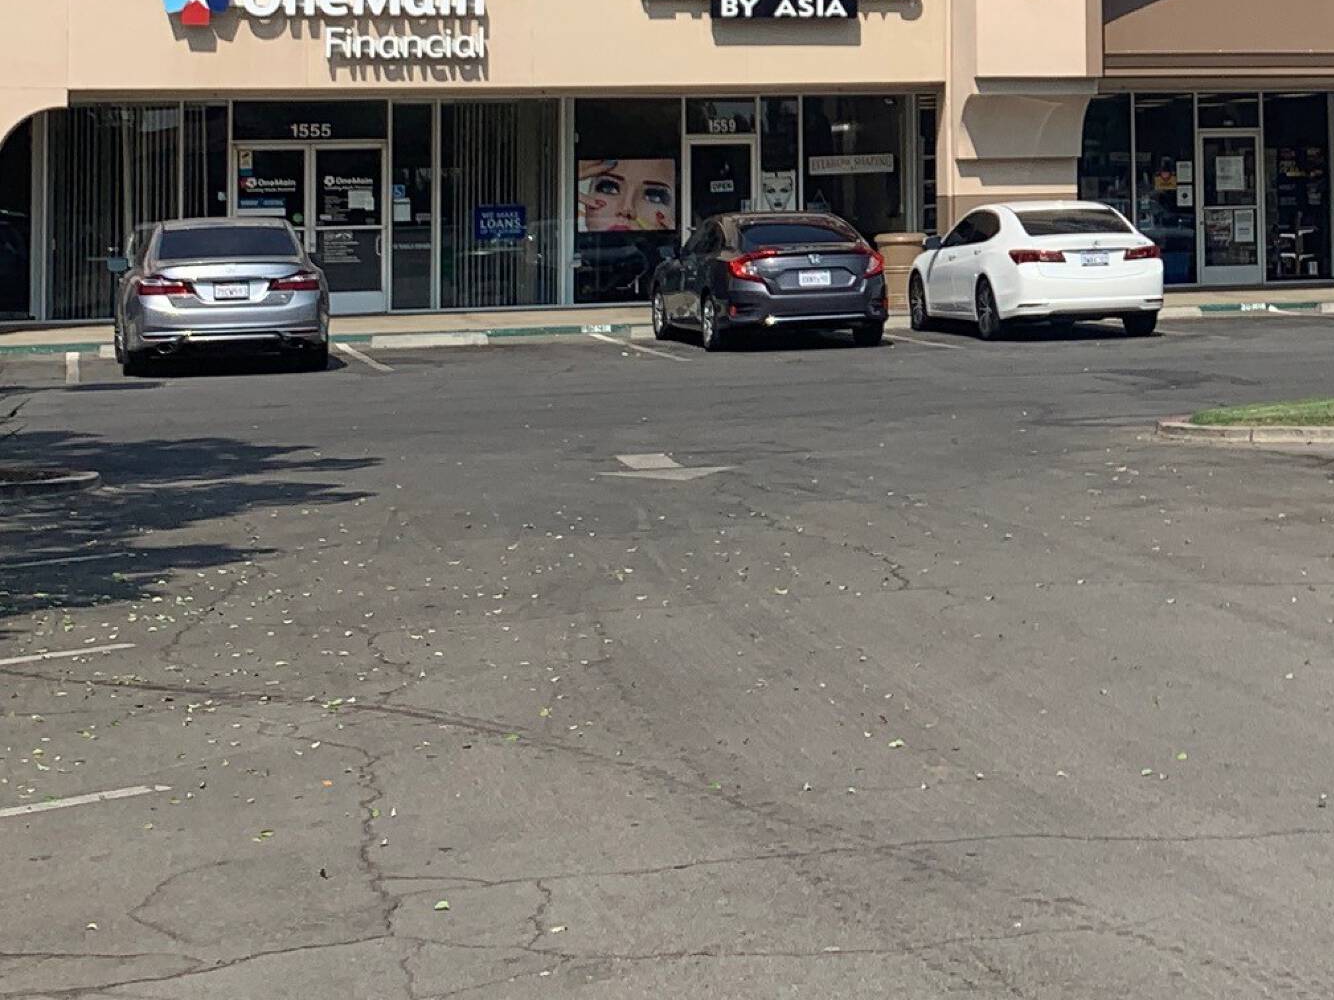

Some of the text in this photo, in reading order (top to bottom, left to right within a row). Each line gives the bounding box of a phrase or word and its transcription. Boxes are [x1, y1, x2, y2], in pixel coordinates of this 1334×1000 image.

[324, 26, 485, 59] Financial
[290, 123, 332, 138] 1555
[708, 118, 737, 133] 1559
[480, 218, 521, 229] LOANS
